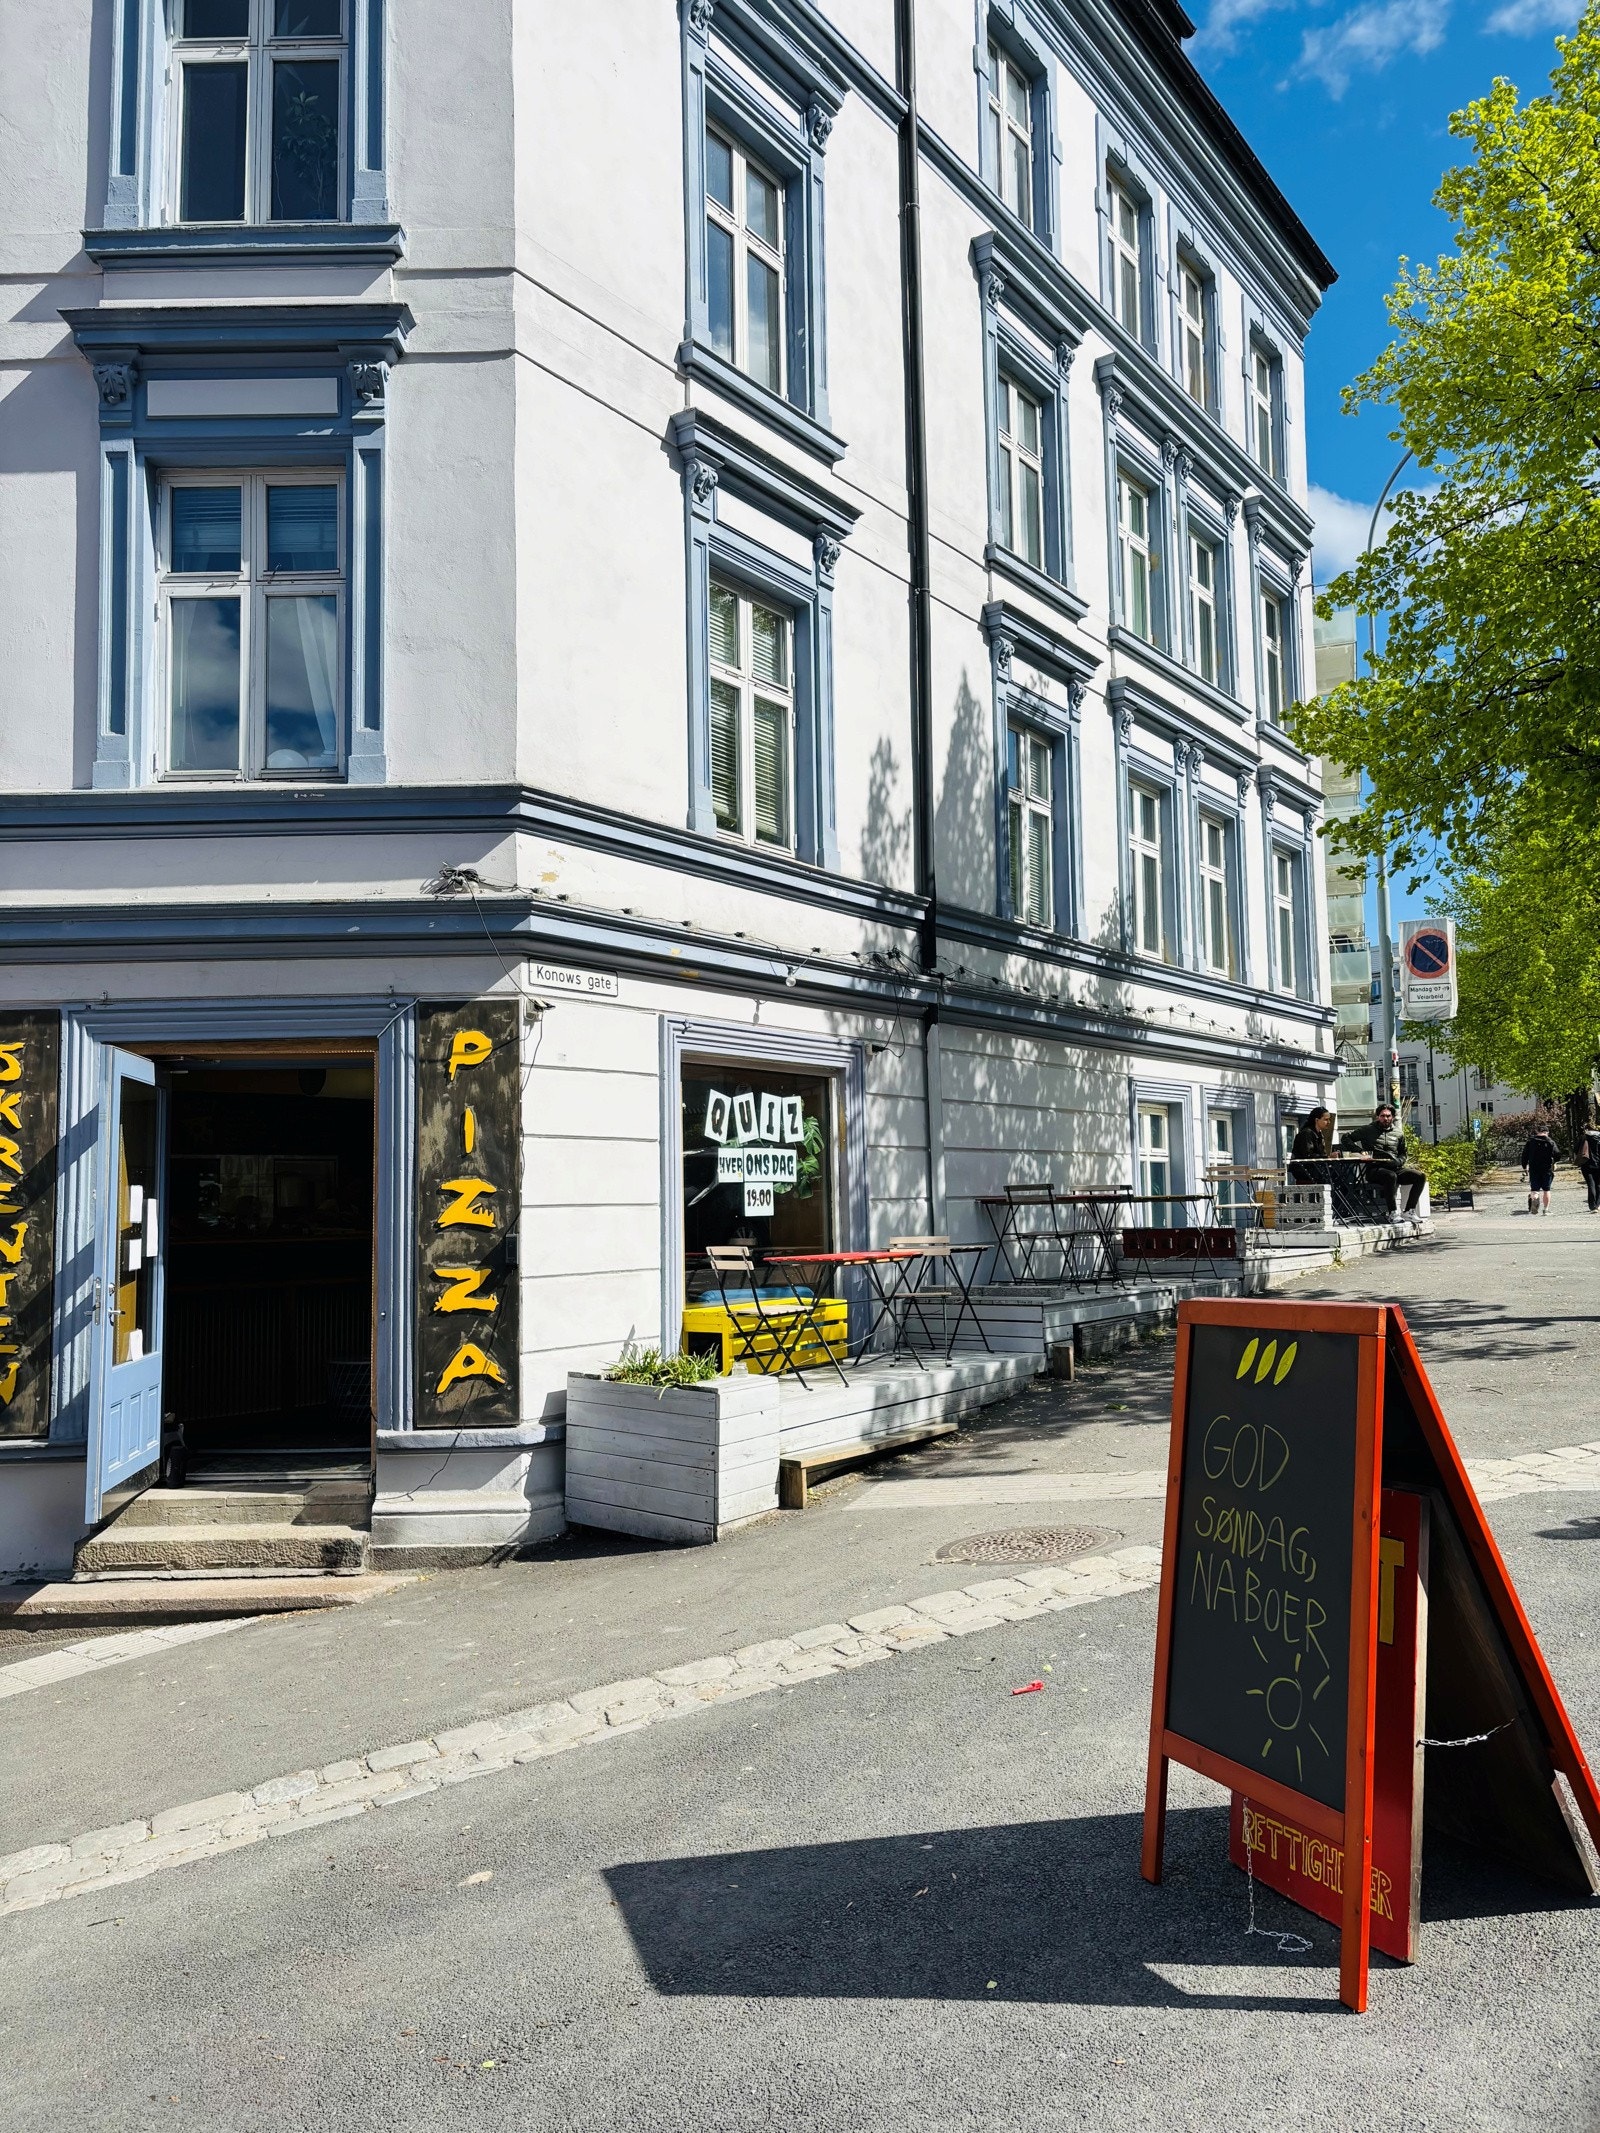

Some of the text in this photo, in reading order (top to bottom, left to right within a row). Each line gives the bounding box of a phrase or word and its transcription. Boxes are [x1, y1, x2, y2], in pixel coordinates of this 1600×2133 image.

[536, 965, 612, 990] Konows gate
[1410, 985, 1432, 993] Mandag
[711, 1097, 799, 1137] QUIZ
[719, 1153, 795, 1176] HVER ONSDAG
[434, 1030, 506, 1393] PIZZA
[1203, 1414, 1290, 1492] GOD
[1194, 1495, 1318, 1583] SØNDAG,
[1190, 1550, 1330, 1669] NABOER
[1241, 1807, 1394, 1922] RETTIGHER
